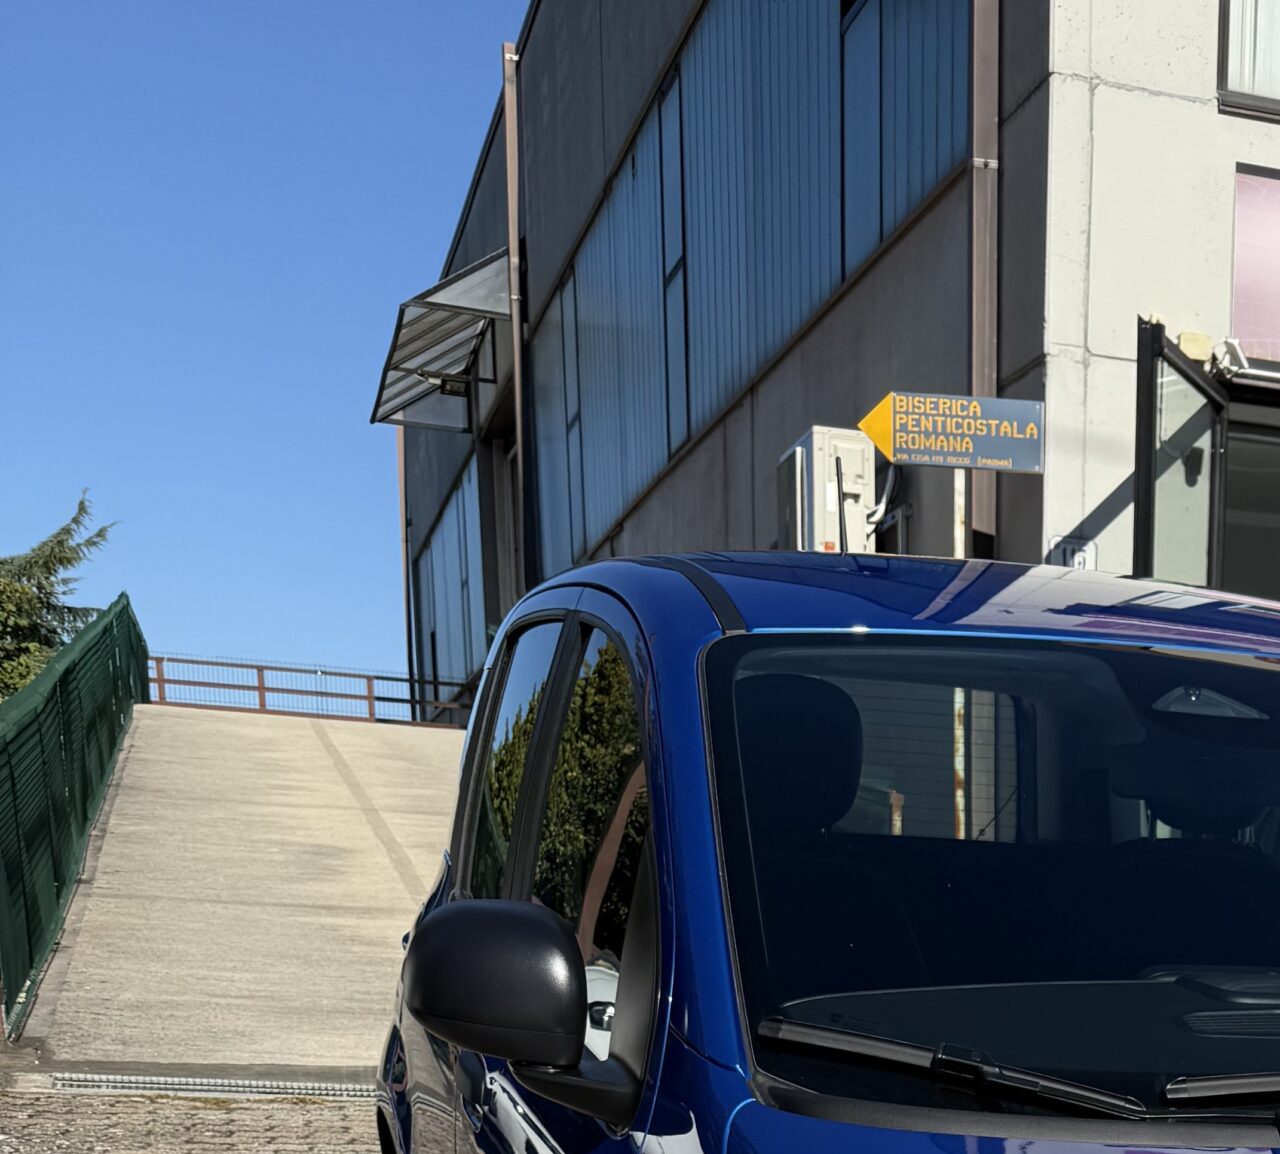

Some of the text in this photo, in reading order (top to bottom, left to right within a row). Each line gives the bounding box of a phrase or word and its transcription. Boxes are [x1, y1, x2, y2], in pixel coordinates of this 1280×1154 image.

[895, 395, 982, 417] BISERICA
[895, 415, 1038, 439] PENTICOSTALA
[895, 432, 974, 453] ROMANA
